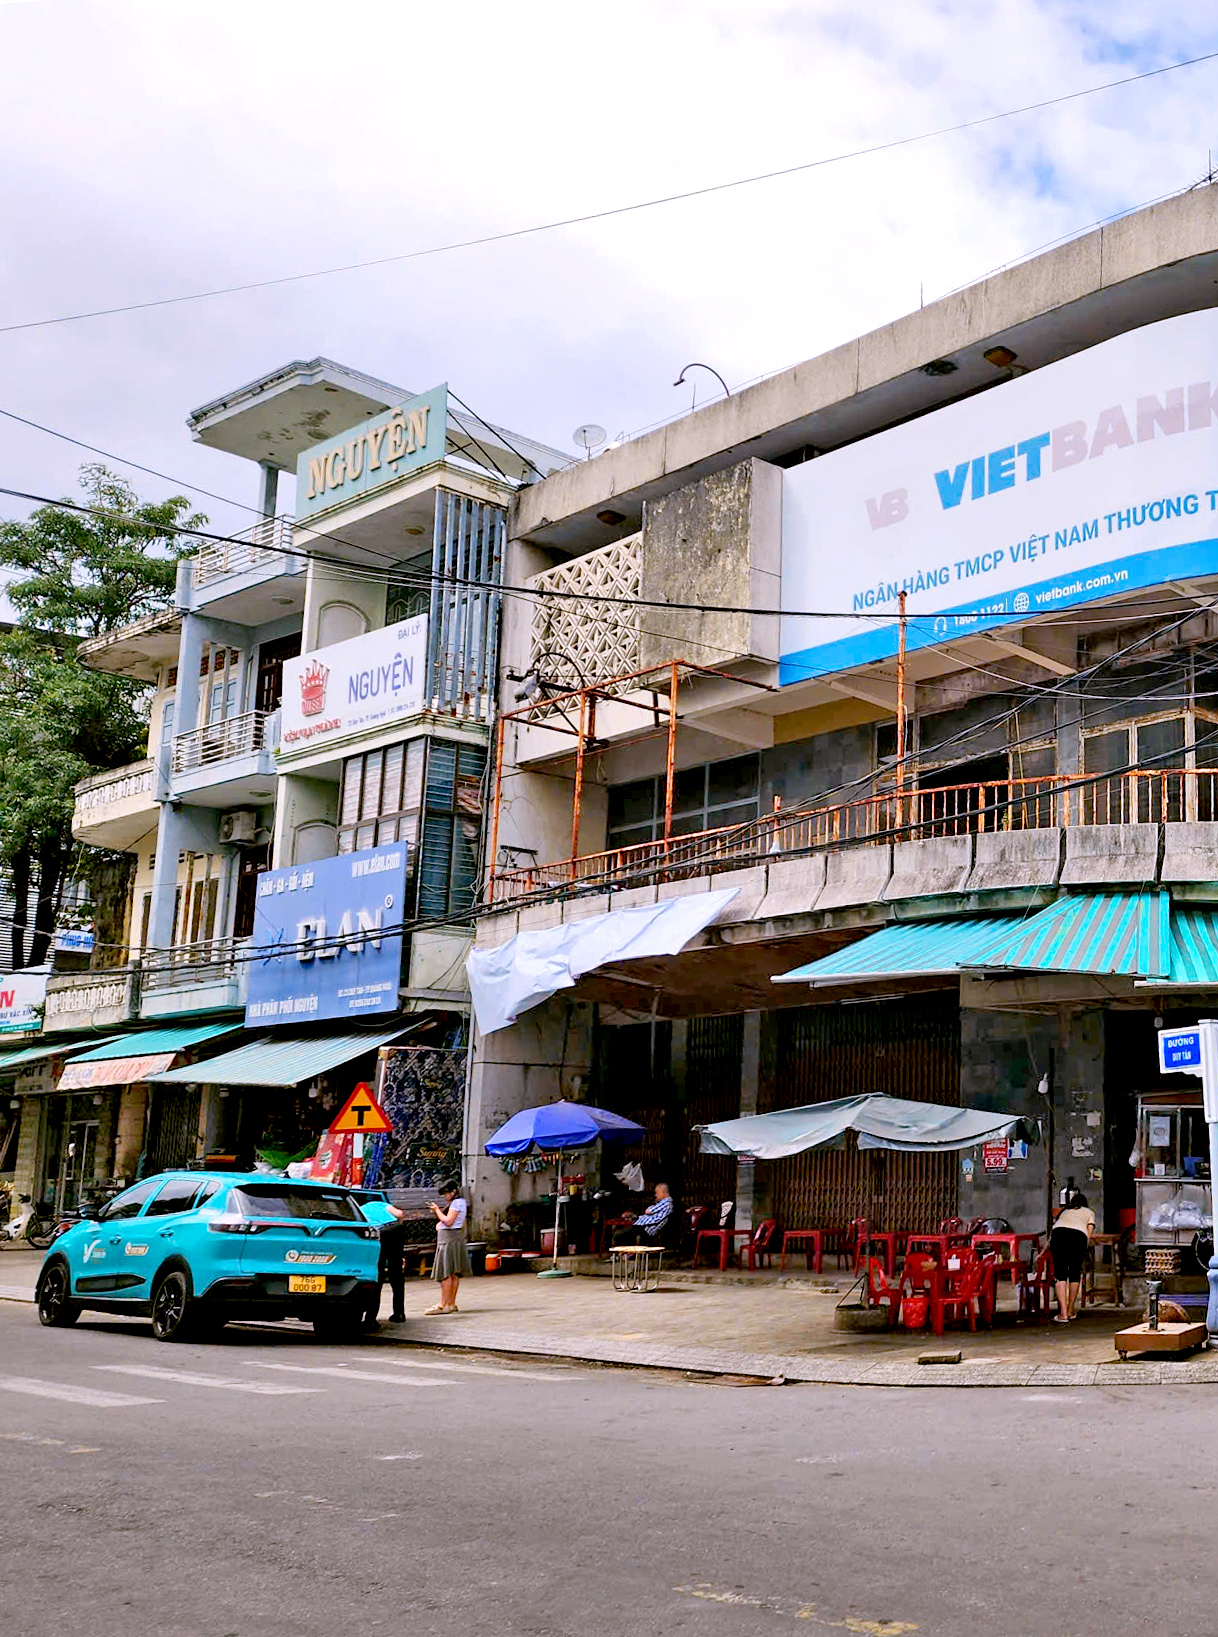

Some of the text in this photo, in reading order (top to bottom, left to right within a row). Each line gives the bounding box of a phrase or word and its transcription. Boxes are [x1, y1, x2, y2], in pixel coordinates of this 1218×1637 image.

[305, 405, 430, 500] NGUYỆN
[865, 487, 909, 532] VB
[853, 581, 899, 611] NGÂN
[903, 567, 950, 596] HÀNG
[954, 550, 1004, 580] TMCP
[1009, 534, 1050, 563] VIỆT
[1055, 519, 1099, 550] NAM
[1104, 493, 1199, 534] THƯƠNG
[1035, 567, 1129, 604] vietbank.com.vn
[348, 652, 414, 704] NGUYỆN
[296, 907, 384, 961] ELAN
[1168, 1036, 1194, 1048] ĐƯỜNG
